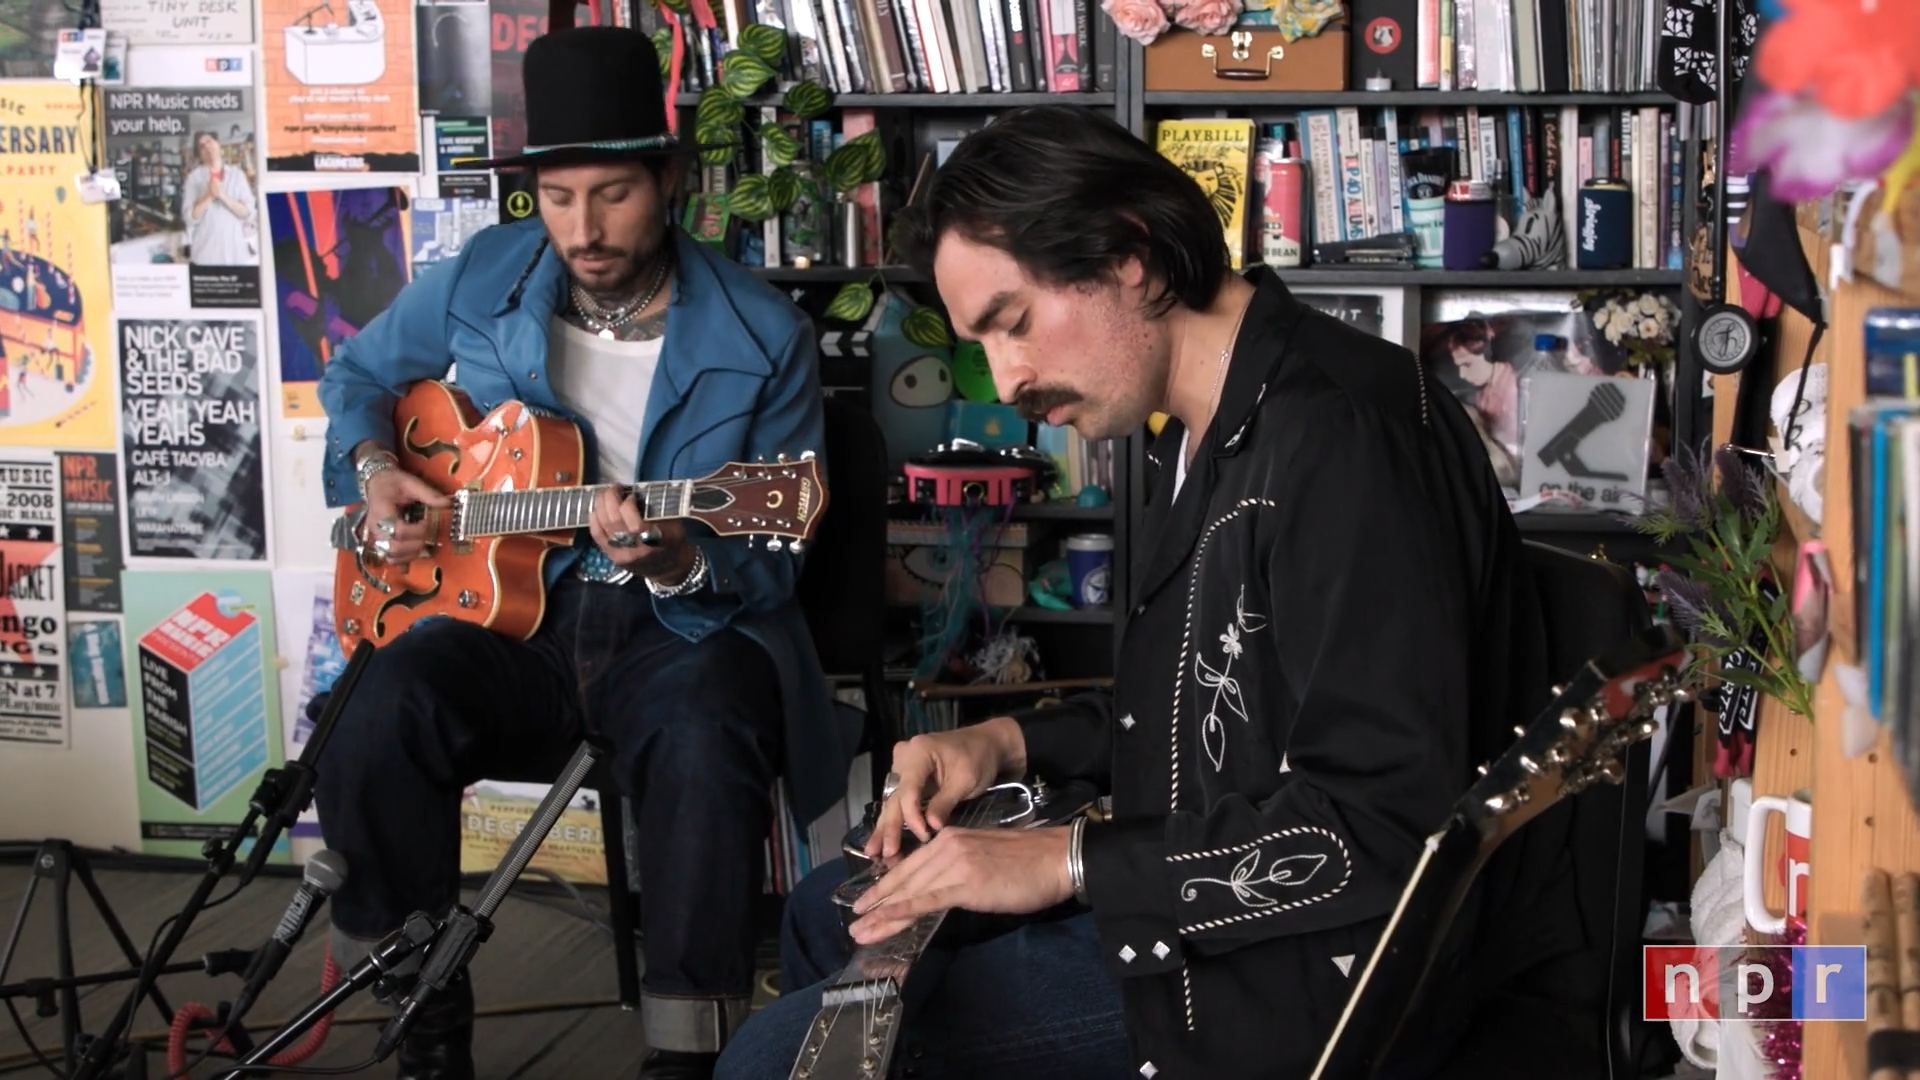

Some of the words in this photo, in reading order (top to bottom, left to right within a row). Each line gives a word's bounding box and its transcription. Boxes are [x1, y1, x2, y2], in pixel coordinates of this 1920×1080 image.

[1077, 15, 1087, 48] WORK
[110, 93, 143, 109] NPR
[147, 92, 189, 109] Music
[193, 93, 239, 109] needs
[111, 118, 144, 136] your
[148, 116, 186, 136] help.
[1162, 129, 1244, 141] PLAYBILL
[6, 165, 56, 176] PARTY
[1345, 153, 1360, 177] TOP
[1347, 178, 1361, 195] 40
[1348, 197, 1363, 238] ALBUMS
[125, 326, 182, 350] NICK
[186, 326, 245, 350] CAVE
[193, 350, 242, 374] BAD
[126, 372, 203, 395] SEEDS
[128, 400, 190, 423] YEAH
[194, 401, 255, 424] YEAH
[129, 423, 205, 446] YEAHS
[63, 455, 97, 479] NPR
[7, 493, 54, 508] 2008
[64, 479, 114, 502] MUSIC
[1568, 481, 1596, 501] the
[24, 684, 42, 698] at
[467, 814, 603, 843] DECEBERI
